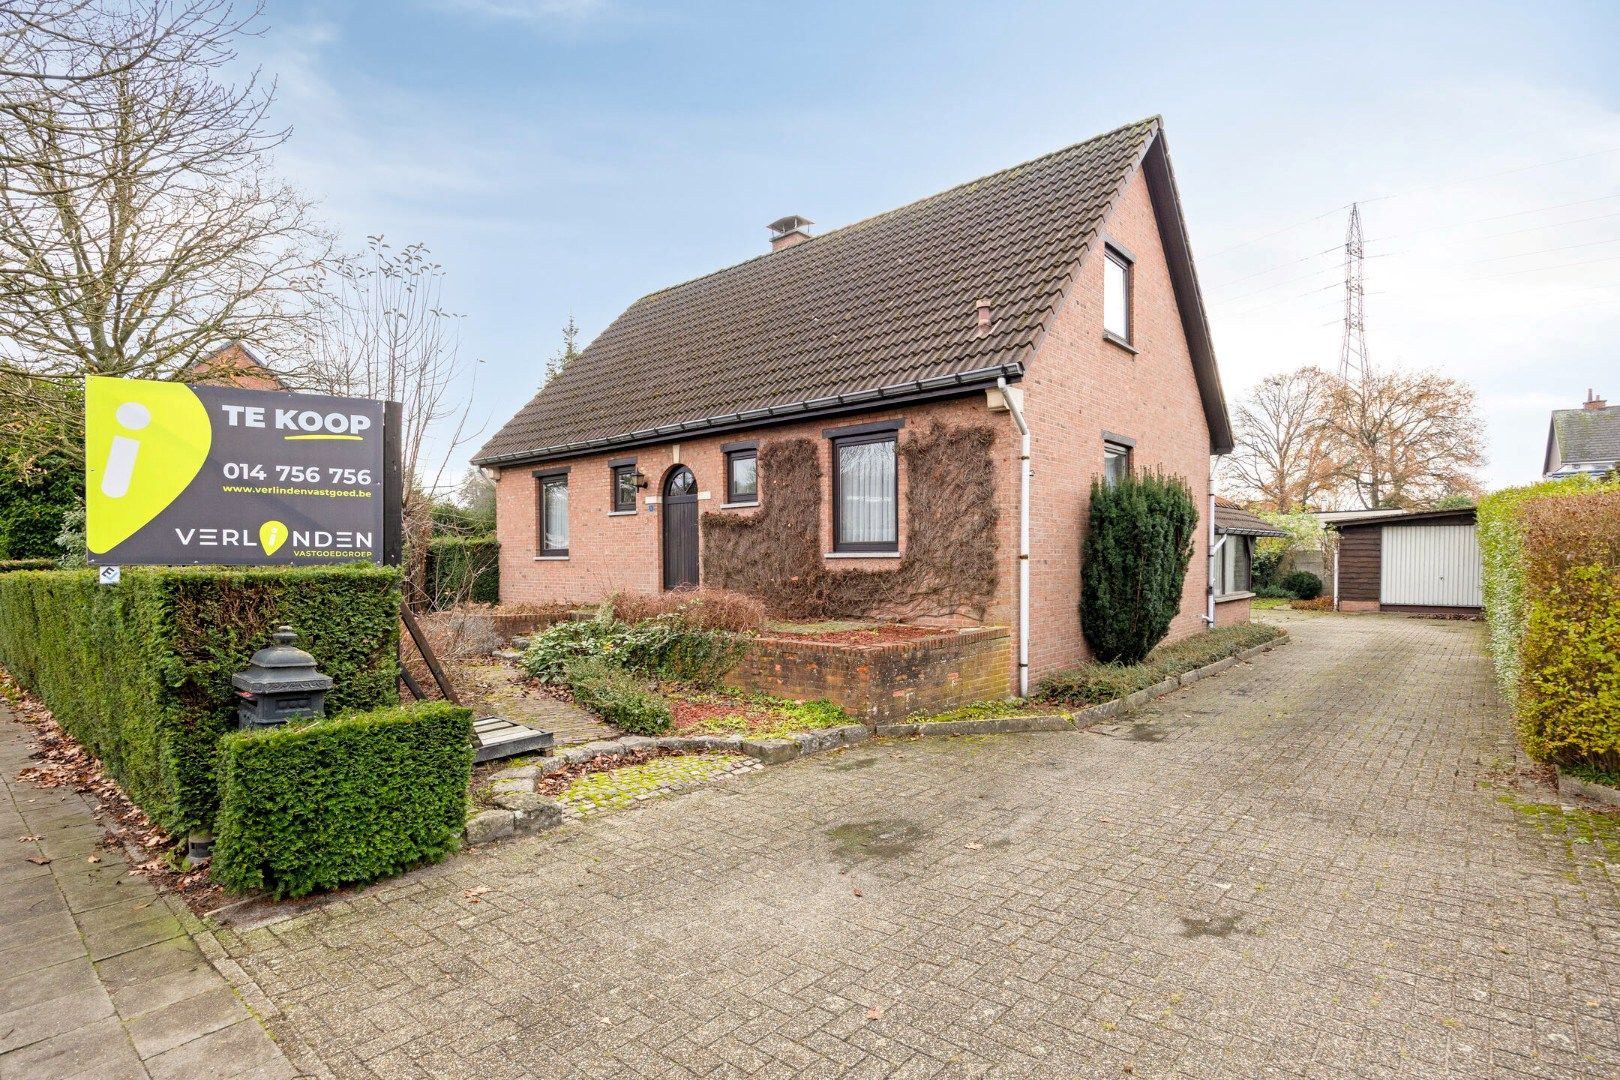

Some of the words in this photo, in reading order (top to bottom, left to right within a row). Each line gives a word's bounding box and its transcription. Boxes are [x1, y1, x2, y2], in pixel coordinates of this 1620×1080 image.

[221, 404, 266, 428] TE
[275, 408, 371, 434] KOOP
[223, 462, 267, 480] 014
[275, 465, 320, 483] 756
[328, 467, 371, 485] 756
[222, 485, 372, 498] www.verlindenvastgoed.be
[293, 550, 372, 558] VASTGOEDGROEP
